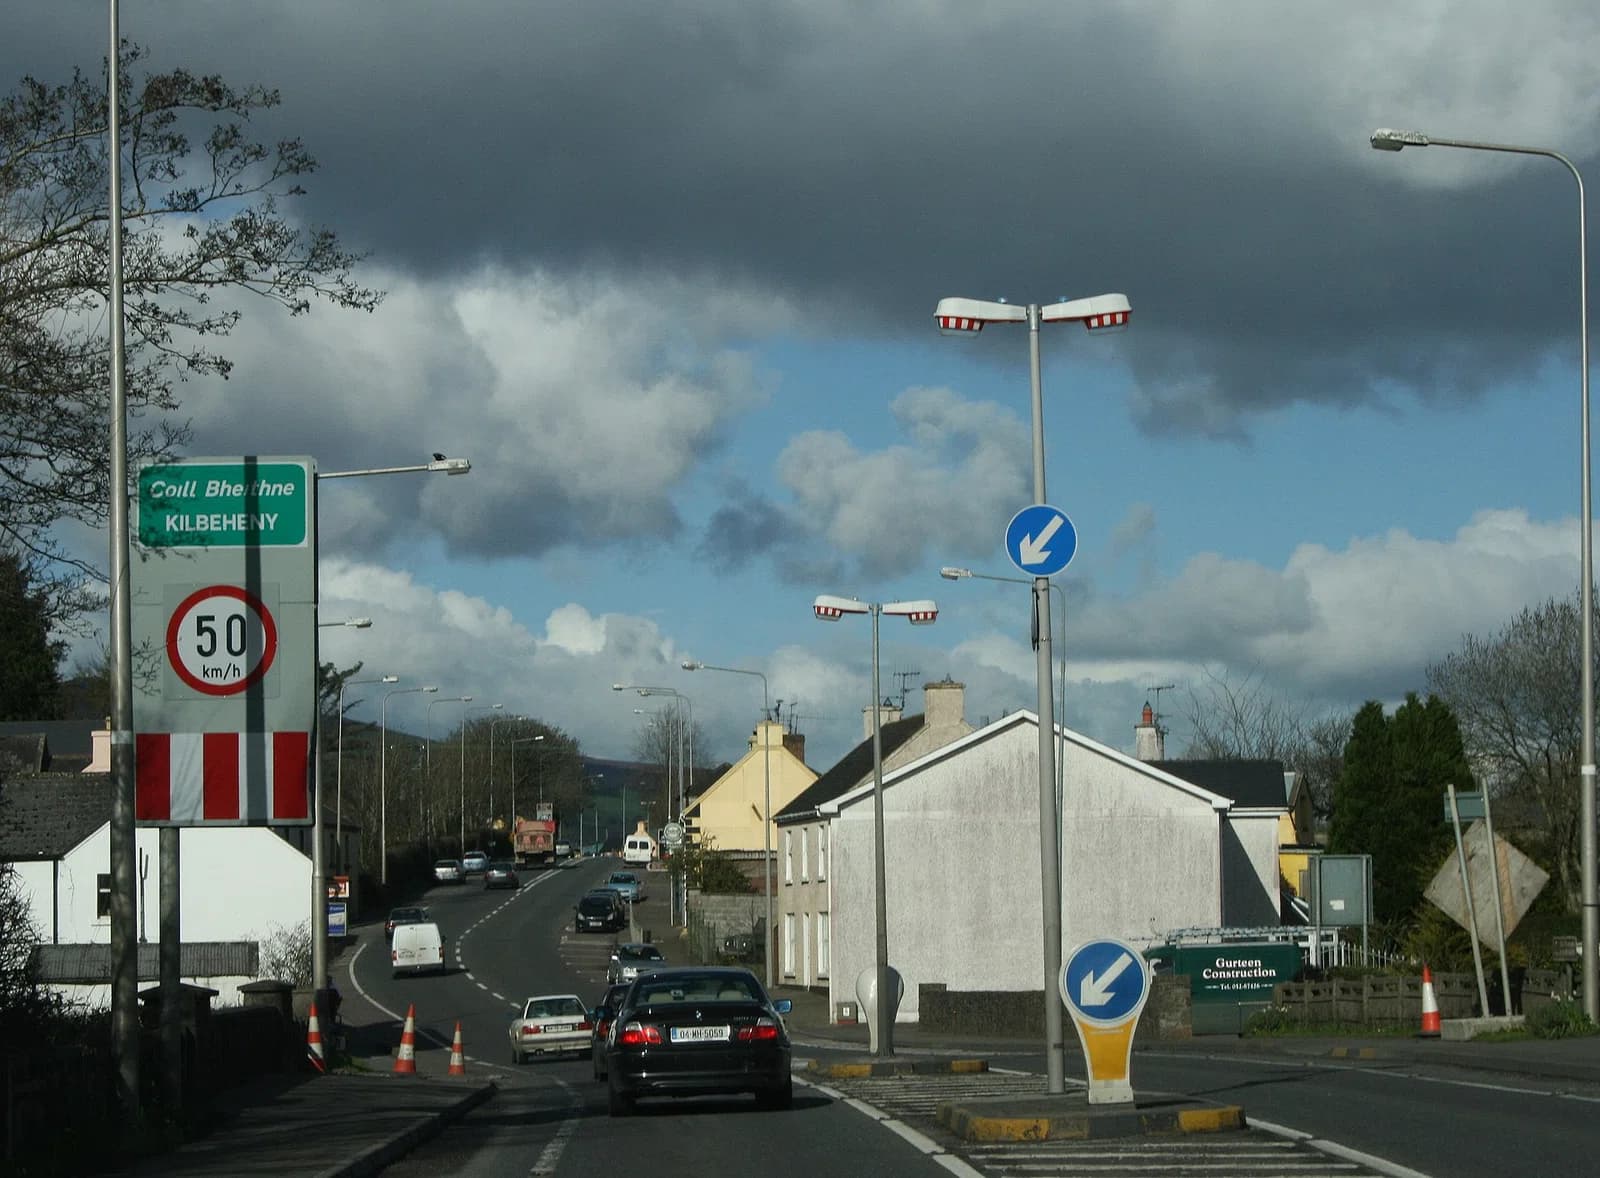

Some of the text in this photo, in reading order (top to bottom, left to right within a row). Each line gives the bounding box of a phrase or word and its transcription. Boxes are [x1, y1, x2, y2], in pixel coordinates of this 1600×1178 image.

[166, 513, 279, 531] KILBEHENY
[196, 614, 247, 657] 50
[203, 663, 241, 680] km/h
[1215, 958, 1262, 968] Gurteen
[1202, 968, 1277, 979] Construction
